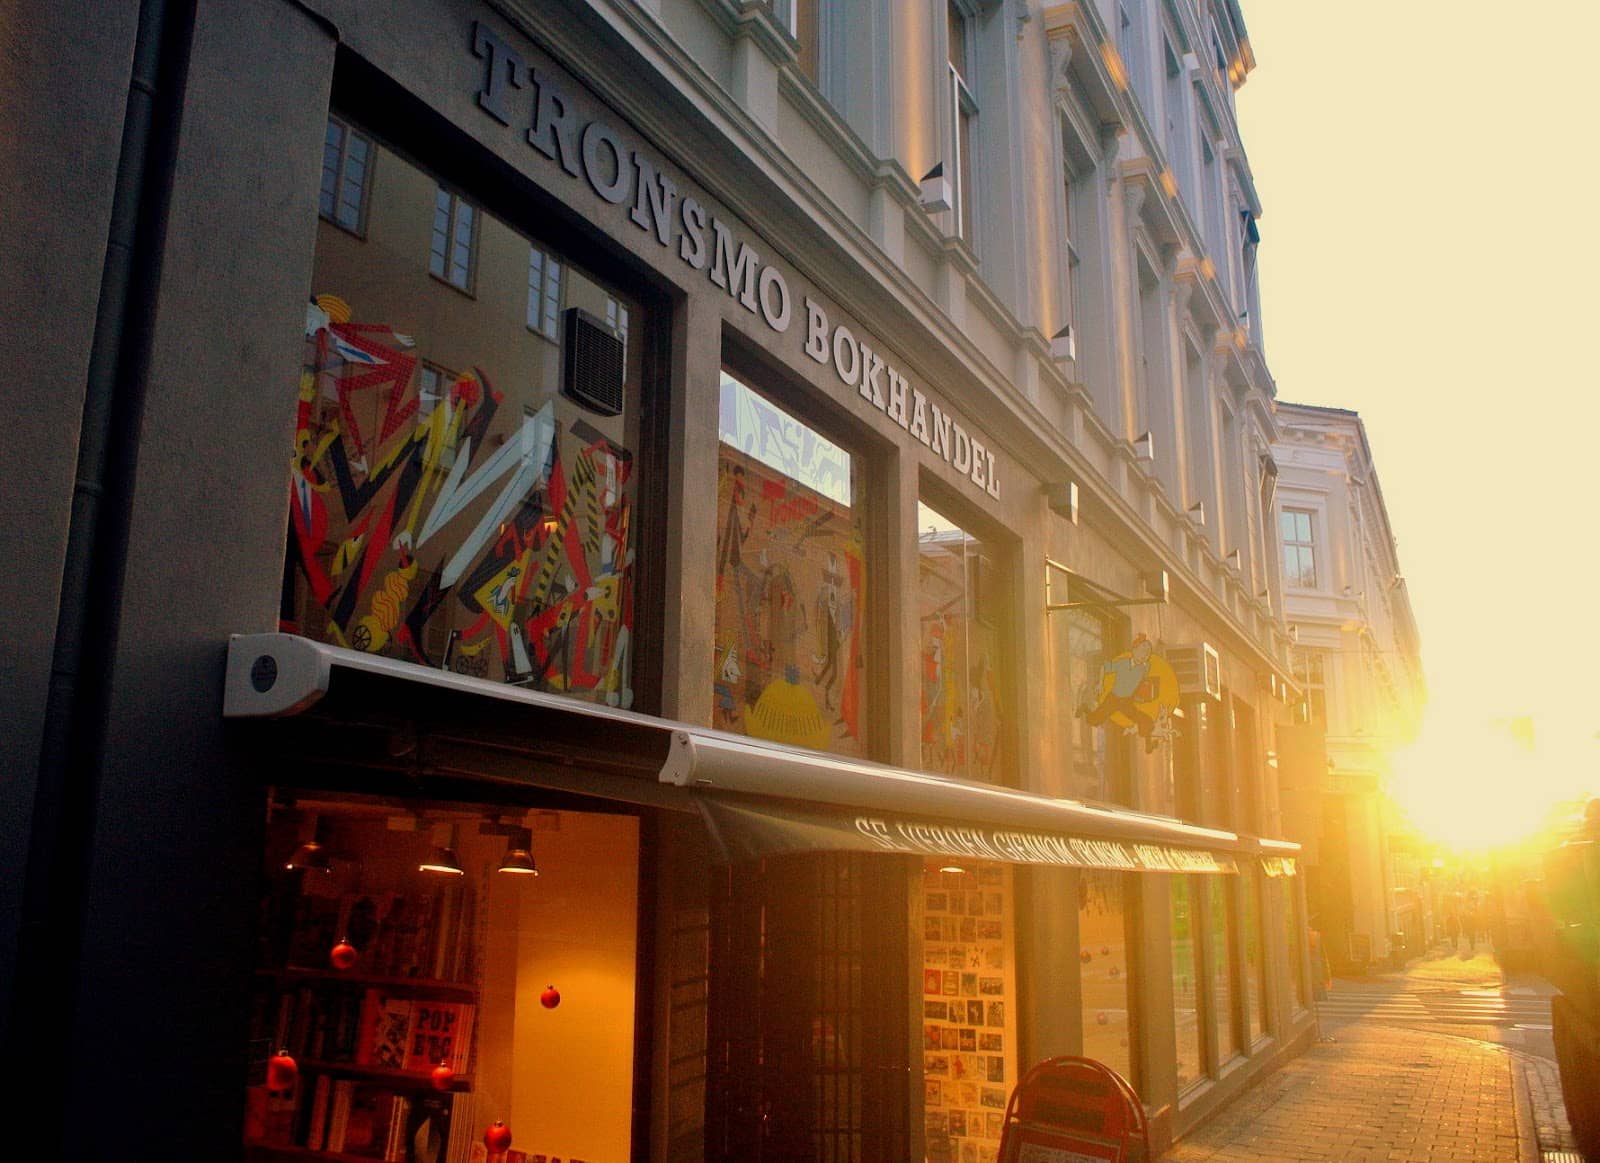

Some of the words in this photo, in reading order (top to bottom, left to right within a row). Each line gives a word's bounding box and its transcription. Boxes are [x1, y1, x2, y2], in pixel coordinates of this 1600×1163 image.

[469, 19, 792, 335] TRONSMO
[803, 296, 1001, 502] BOKHANDEL
[855, 816, 912, 850] SE
[896, 822, 1003, 861] VERDEN
[416, 1007, 456, 1033] POP
